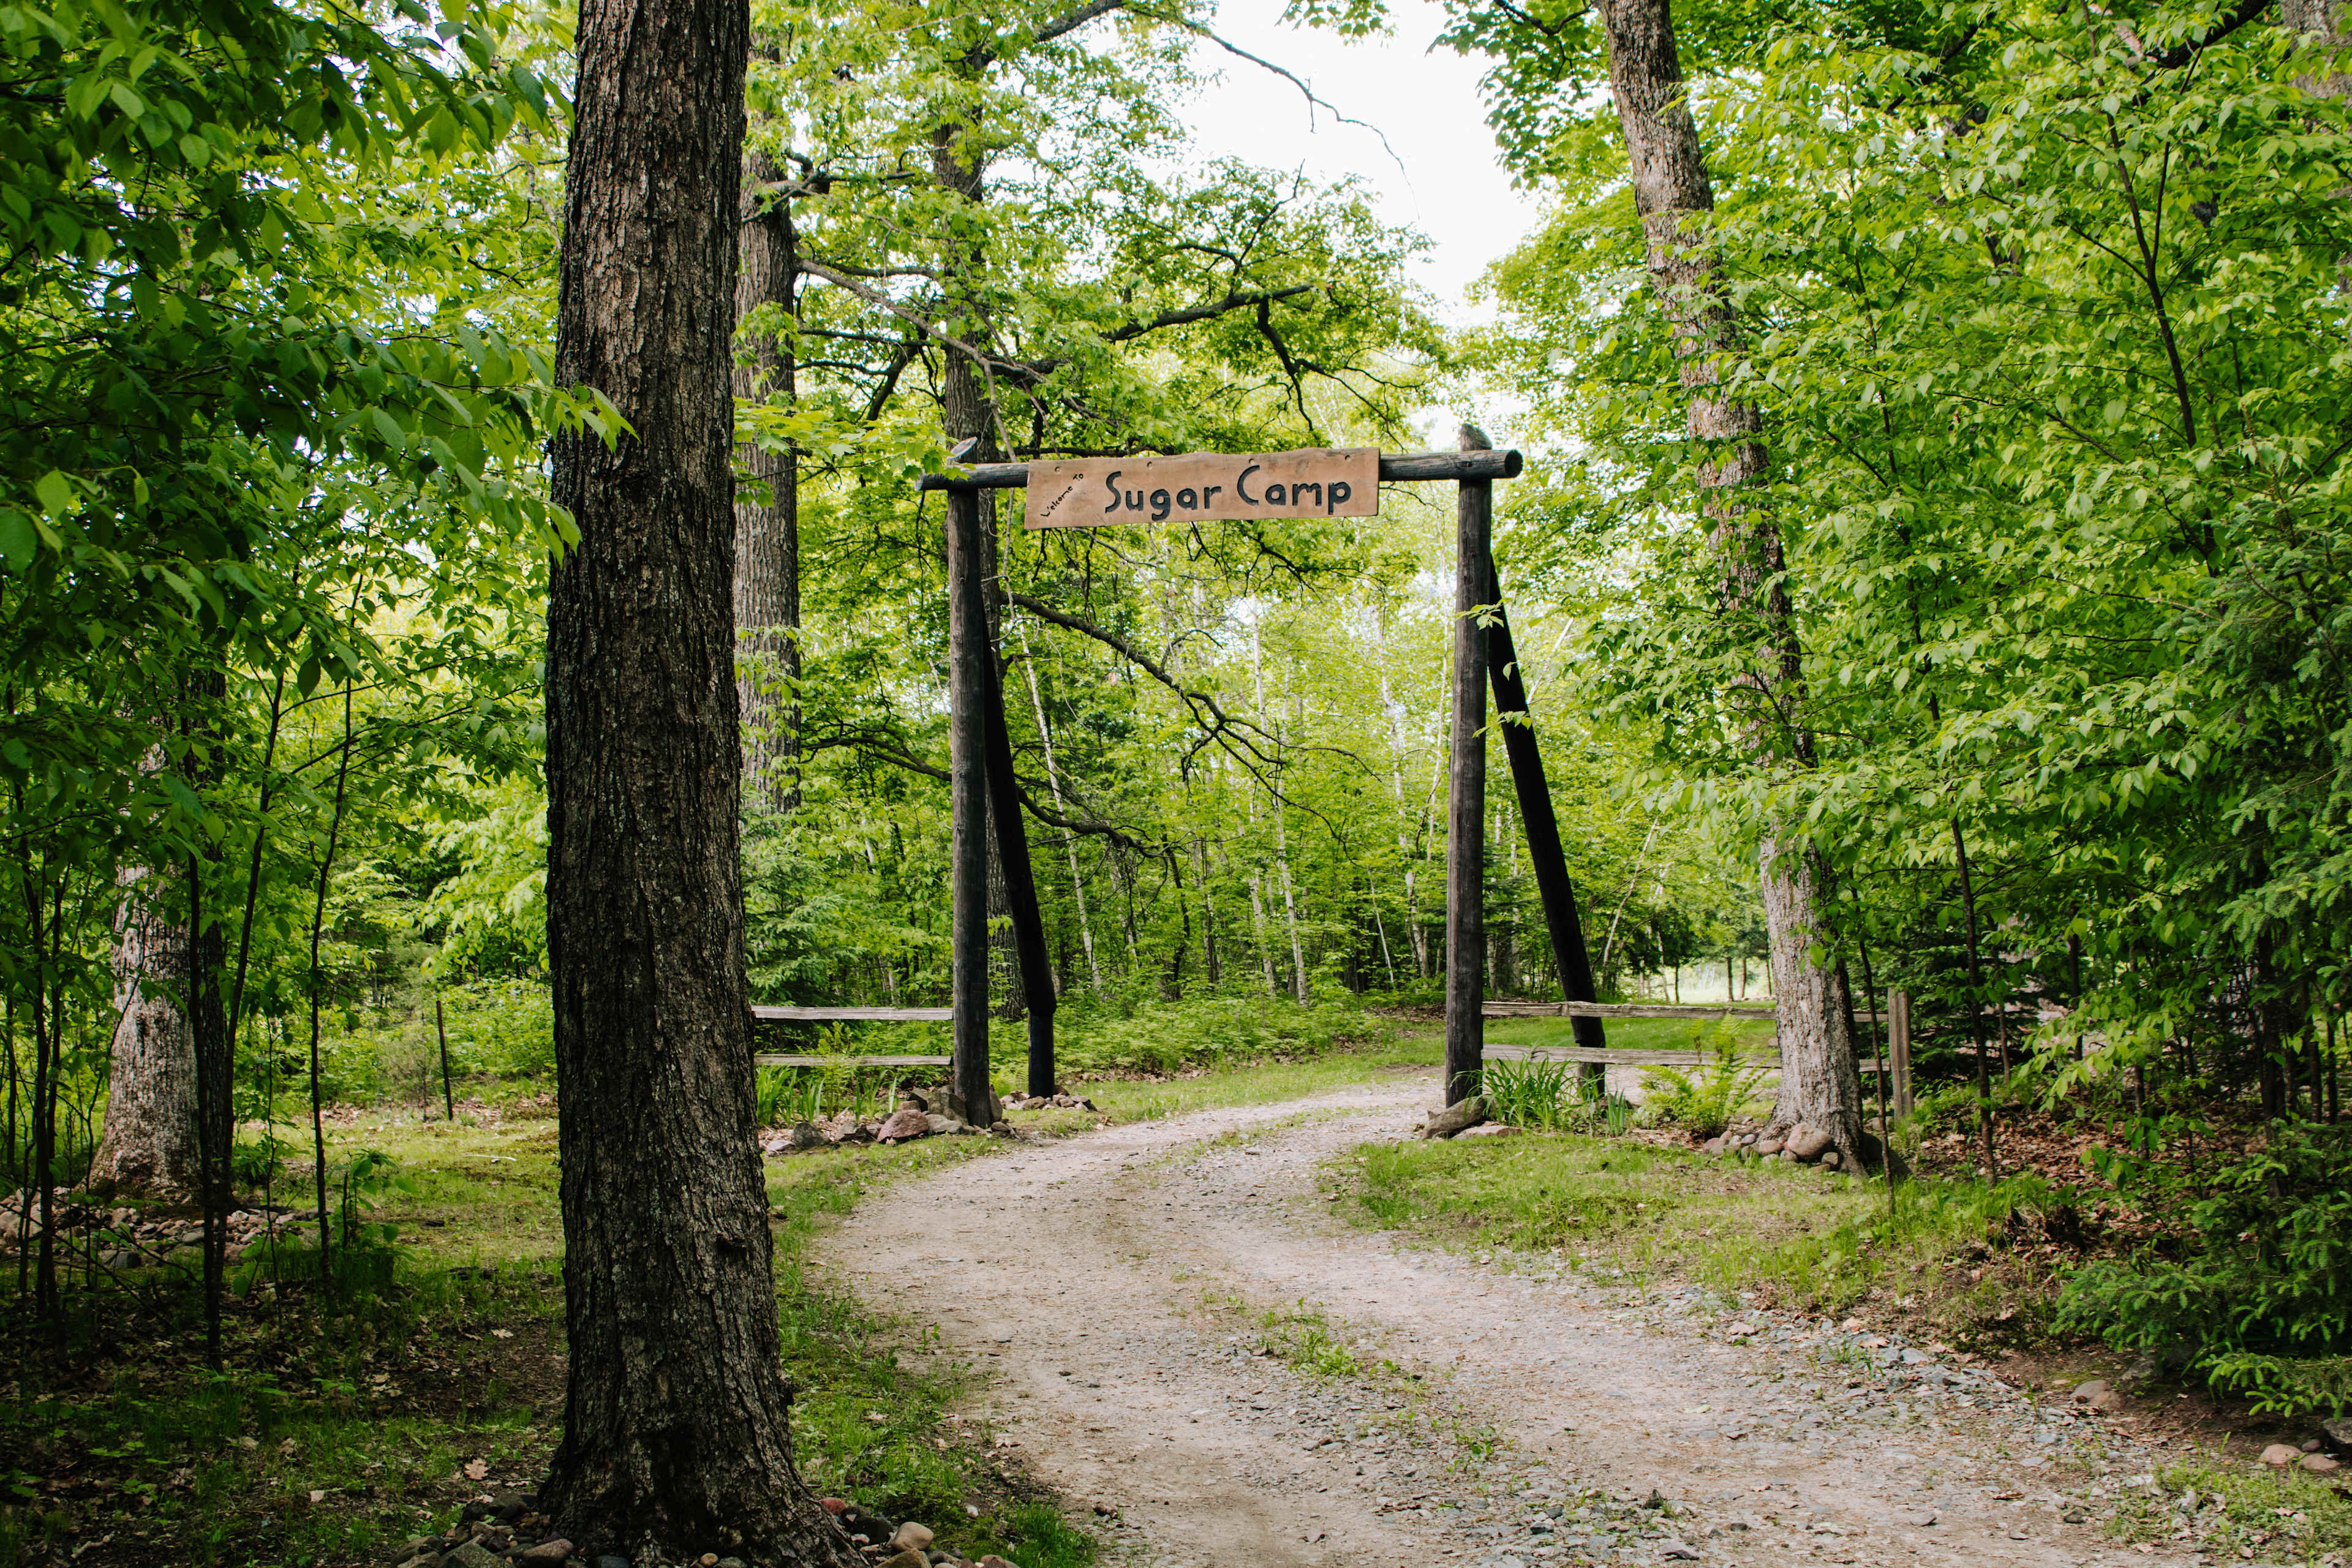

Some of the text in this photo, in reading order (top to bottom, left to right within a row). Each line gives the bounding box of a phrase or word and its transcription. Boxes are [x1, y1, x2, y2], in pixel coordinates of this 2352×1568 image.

[1040, 473, 1084, 516] Welcome To
[1105, 465, 1351, 521] Sugar Camp
